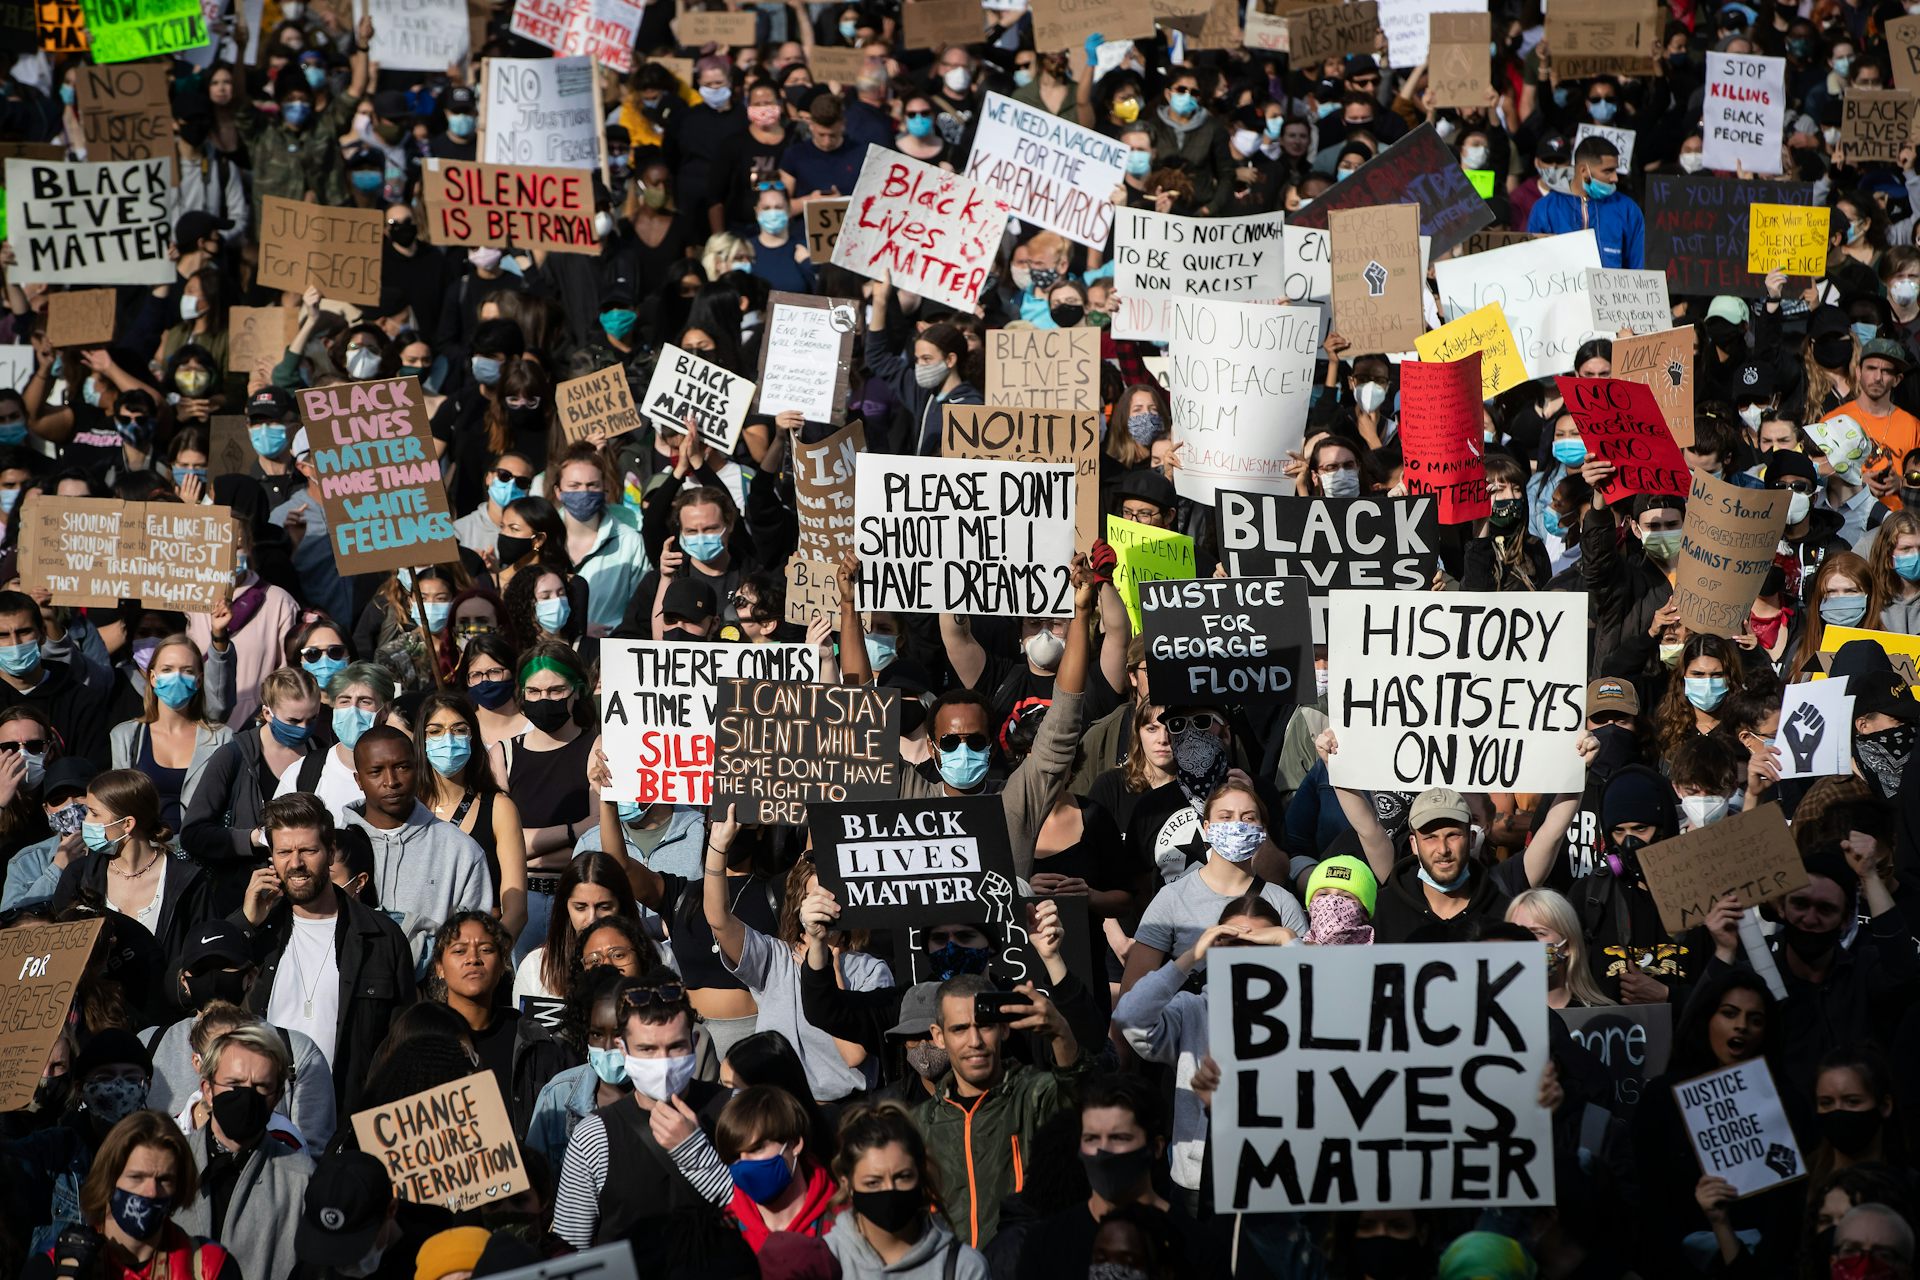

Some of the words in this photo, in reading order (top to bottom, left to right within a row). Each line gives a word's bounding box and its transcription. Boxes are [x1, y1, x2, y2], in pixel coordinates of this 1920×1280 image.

[1308, 1, 1363, 29] BLACK
[88, 68, 143, 99] NO
[498, 66, 541, 104] NO
[1723, 60, 1766, 79] STOP
[1711, 83, 1770, 104] KILLING
[513, 103, 594, 131] JUSTICE
[1723, 108, 1766, 127] BLACK
[1846, 100, 1908, 121] BLACK
[84, 111, 168, 143] JUSTICE
[987, 98, 1007, 122] WE
[1010, 107, 1050, 137] NEED
[1050, 121, 1067, 143] A
[1064, 122, 1127, 169] VACCINE
[1714, 126, 1764, 145] PEOPLE
[1854, 121, 1909, 140] LIVES
[1014, 138, 1050, 166] FOR
[1053, 151, 1086, 186] THE
[32, 161, 166, 199] BLACK
[444, 166, 580, 210] SILENCE
[882, 163, 986, 225] Black
[1653, 182, 1671, 205] IF
[1686, 186, 1723, 206] YOU
[1734, 184, 1767, 205] ARE
[23, 192, 168, 229] LIVES
[271, 205, 381, 245] JUSTICE
[859, 195, 945, 249] Lives
[1332, 207, 1390, 233] GEORGE
[1656, 209, 1718, 232] ANGRY
[441, 208, 472, 240] IS
[486, 209, 600, 247] BETRAYAL
[1133, 215, 1153, 241] IT
[1164, 221, 1184, 243] IS
[1192, 223, 1233, 244] NOT
[1232, 219, 1283, 245] ENOUGH
[1758, 231, 1812, 248] SILENCE
[29, 221, 173, 272] MATTER
[1116, 245, 1141, 266] TO
[1147, 248, 1171, 270] BE
[1182, 251, 1263, 272] QUIETLY
[304, 250, 381, 297] REGIS
[868, 240, 986, 301] MATTER
[1758, 256, 1824, 275] VIOLENCE
[1136, 273, 1171, 291] NON
[1186, 275, 1259, 295] RACIST
[1613, 274, 1631, 289] NOT
[1633, 275, 1659, 290] WHITE
[1335, 297, 1377, 316] REGIS
[1594, 294, 1607, 306] VS
[1597, 308, 1654, 323] EVERYBODY
[776, 308, 797, 322] IN
[802, 311, 826, 325] THE
[1174, 303, 1217, 345] NO
[1230, 310, 1319, 355] JUSTICE
[800, 328, 817, 339] WE
[996, 331, 1089, 359] BLACK
[1622, 341, 1666, 369] NONE
[567, 375, 610, 402] ASIANS
[613, 371, 622, 388] 4
[674, 355, 736, 396] BLACK
[1001, 359, 1090, 388] LIVES
[1174, 355, 1211, 392] NO
[304, 381, 414, 421] BLACK
[567, 392, 616, 423] BLACK
[674, 379, 730, 415] LIVES
[991, 388, 1089, 410] MATTER
[1575, 382, 1632, 412] NO
[331, 410, 413, 445] LIVES
[606, 408, 640, 433] POWER
[948, 411, 1023, 453] NO!
[1029, 413, 1063, 455] IT
[1070, 415, 1096, 451] IS
[1569, 411, 1668, 440] Justice
[315, 437, 425, 473] MATTER
[1403, 456, 1421, 471] SO
[1427, 461, 1463, 475] MANY
[1600, 438, 1651, 461] NO
[321, 469, 378, 500] MORE
[375, 460, 441, 490] THAN
[884, 471, 990, 513] PLEASE
[1000, 471, 1075, 520] DON'T
[342, 488, 430, 520] WHITE
[1692, 478, 1714, 506] We
[1720, 498, 1774, 520] Stand
[60, 512, 122, 535] SHOULDNT
[146, 514, 173, 538] FEEL
[200, 517, 233, 544] THIS
[336, 511, 455, 556] FEELINGS
[858, 515, 950, 559] SHOOT
[958, 515, 1008, 562] ME!
[1221, 491, 1431, 556] BLACK
[1687, 511, 1775, 549] TOGETHER
[59, 533, 120, 559] SHOULDNT
[149, 538, 223, 567] PROTEST
[1110, 526, 1136, 549] NOT
[1141, 536, 1178, 561] EVEN
[1182, 545, 1193, 566] A
[1681, 536, 1732, 571] AGAINST
[66, 552, 96, 572] YOU
[104, 557, 165, 580] TREATING
[166, 563, 194, 579] THEM
[194, 567, 236, 586] WRONG
[1697, 577, 1722, 591] OF
[46, 574, 80, 592] THEY
[90, 578, 131, 599] HAVE
[142, 580, 215, 603] RIGHTS!
[858, 560, 934, 610] HAVE
[944, 560, 1049, 614] DREAMS
[1053, 565, 1073, 614] 2
[1142, 580, 1285, 612] JUSTICE
[1202, 614, 1255, 634] FOR
[1362, 603, 1565, 663] HISTORY
[1152, 634, 1268, 661] GEORGE
[627, 647, 728, 688] THERE
[737, 647, 814, 683] COMES
[1188, 665, 1292, 694] FLOYD
[604, 690, 628, 726] A
[633, 691, 692, 728] TIME
[727, 679, 750, 714] I
[752, 682, 826, 719] CAN'T
[824, 687, 894, 729] STAY
[1343, 674, 1428, 728] HAS
[1498, 678, 1584, 732] EYES
[719, 716, 810, 756] SILENT
[815, 722, 885, 761] WHILE
[718, 753, 773, 778] SOME
[778, 757, 840, 783] DON'T
[843, 761, 894, 785] HAVE
[1393, 730, 1457, 786] ON
[1468, 733, 1524, 788] YOU
[715, 775, 745, 795] THE
[751, 778, 812, 802] RIGHT
[815, 782, 847, 802] TO
[841, 809, 967, 840] BLACK
[848, 844, 969, 873] LIVES
[1642, 838, 1690, 867] BLACK
[844, 877, 977, 907] MATTER
[0, 920, 95, 959] JUSTICE
[18, 953, 51, 981] FOR
[1230, 958, 1528, 1061] BLACK
[1237, 1054, 1527, 1143] LIVES
[1681, 1070, 1749, 1110] JUSTICE
[373, 1085, 478, 1149] CHANGE
[1704, 1097, 1740, 1126] FOR
[1696, 1113, 1764, 1152] GEORGE
[383, 1120, 483, 1178] REQUIRES
[1711, 1136, 1767, 1172] FLOYD
[1232, 1137, 1541, 1210] MATTER
